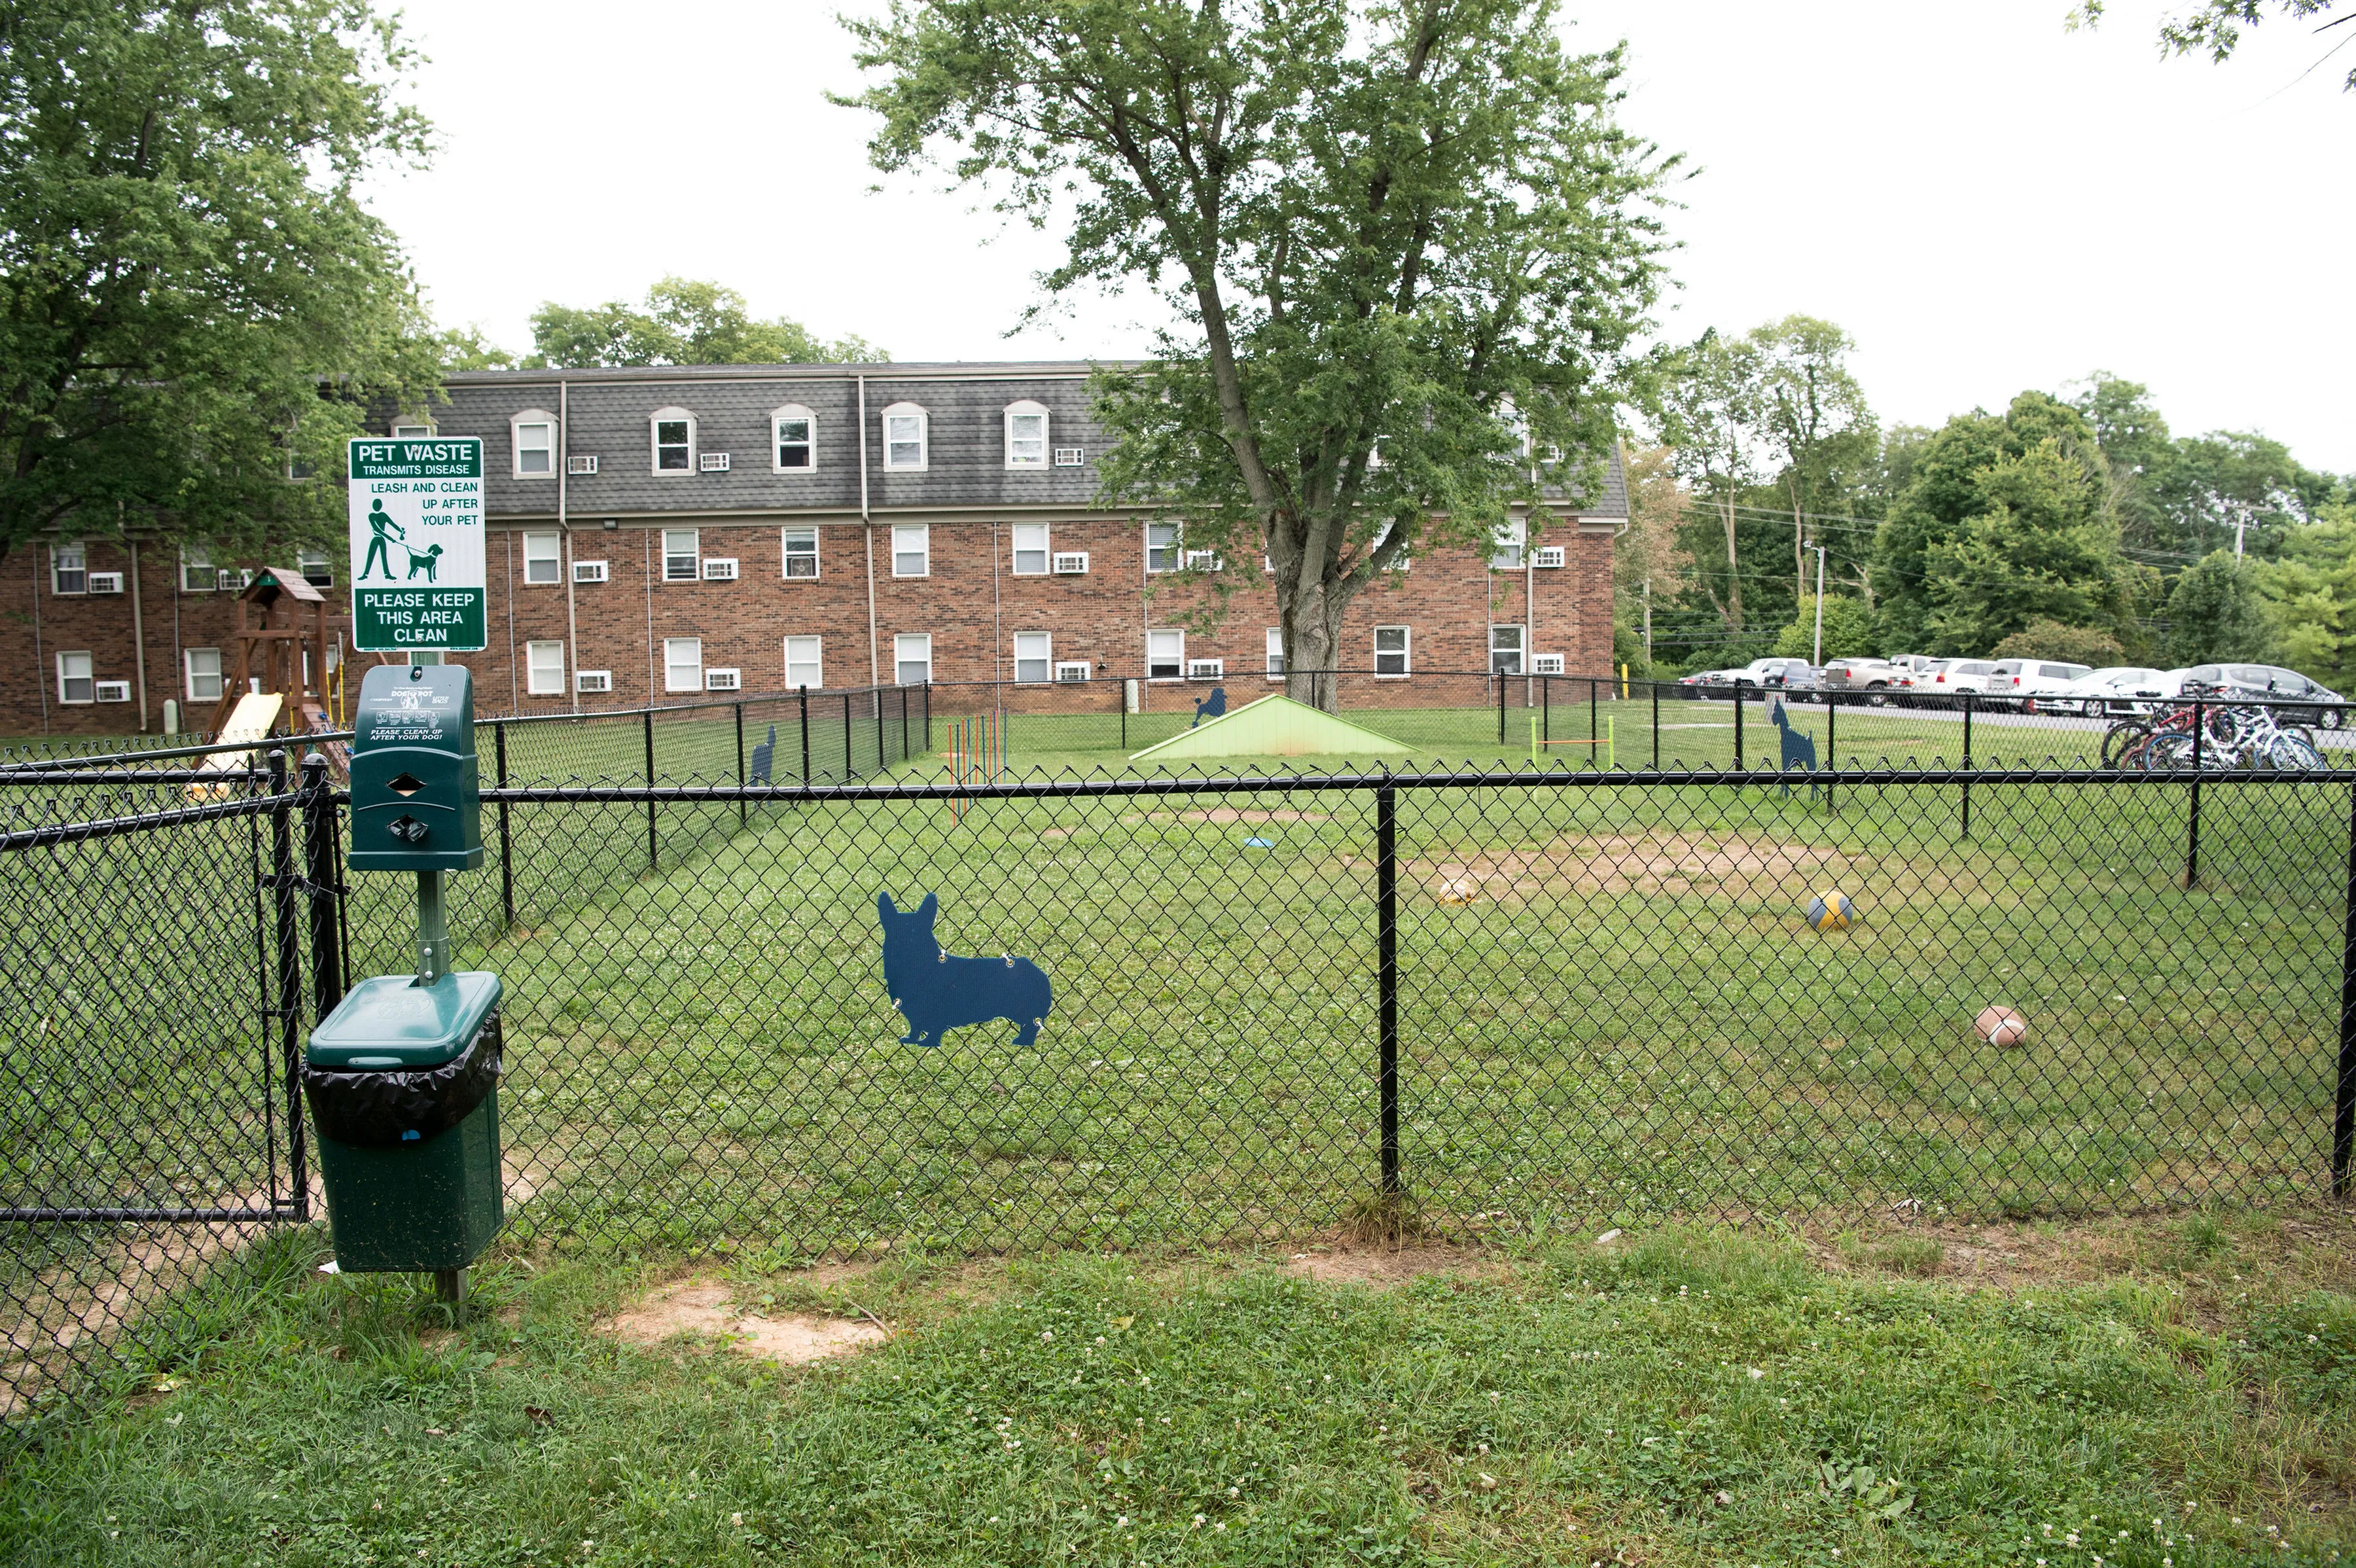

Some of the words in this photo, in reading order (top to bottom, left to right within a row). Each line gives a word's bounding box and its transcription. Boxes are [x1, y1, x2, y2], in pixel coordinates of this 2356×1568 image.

[359, 445, 396, 461] PET
[404, 444, 473, 461] WASTE
[363, 465, 421, 474] TRANSMITS
[425, 465, 469, 474] DISEASE
[371, 483, 407, 493] LEASH
[412, 483, 436, 493] AND
[440, 482, 477, 492] CLEAN
[423, 499, 437, 509] UP
[442, 499, 477, 508] AFTER
[422, 516, 452, 525] YOUR
[457, 515, 478, 525] PET
[364, 594, 425, 607] PLEASE
[432, 594, 474, 606] KEEP
[376, 611, 413, 624] THIS
[420, 611, 463, 624] AREA
[394, 629, 447, 642] CLEAN
